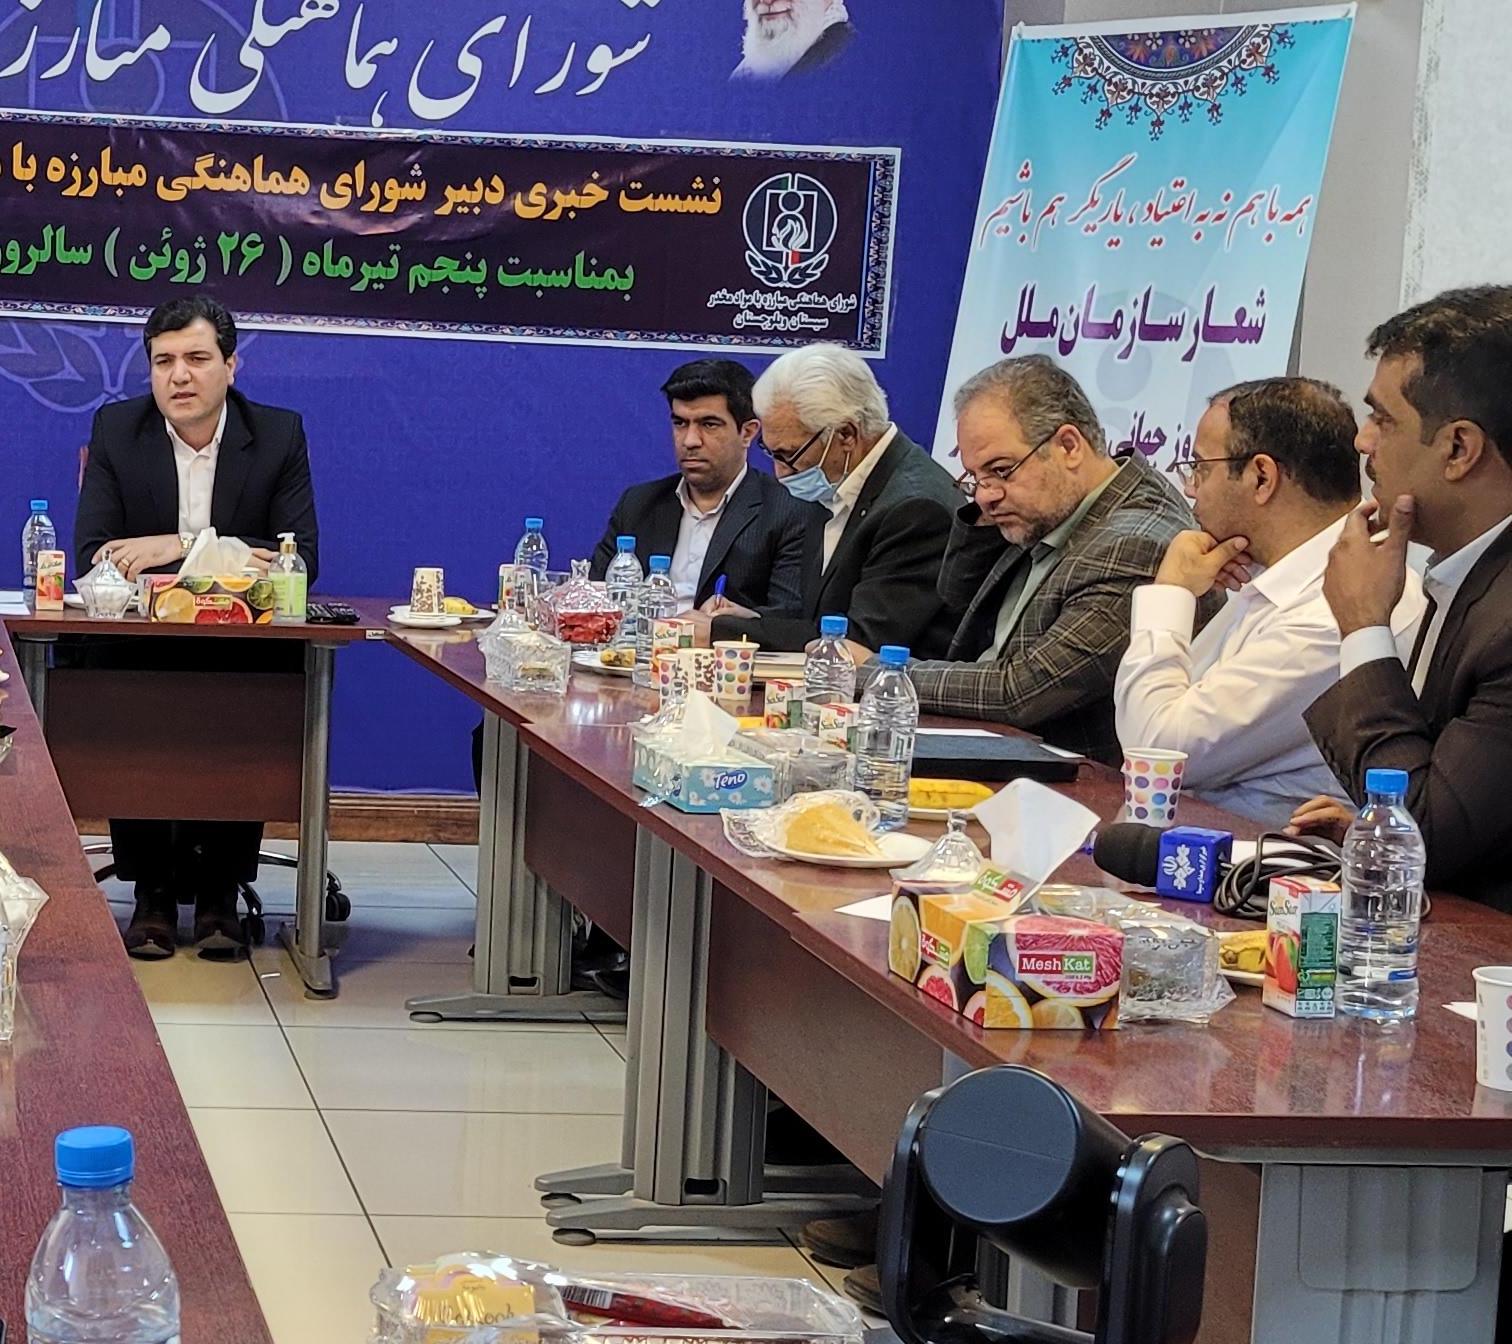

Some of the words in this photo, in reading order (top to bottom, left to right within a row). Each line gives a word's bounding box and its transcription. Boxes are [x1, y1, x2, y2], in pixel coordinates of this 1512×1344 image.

[11, 141, 38, 194] با
[45, 146, 148, 198] مبارزه
[155, 152, 312, 202] هماهنگی
[319, 158, 428, 212] شورای
[433, 172, 506, 219] دبیر
[513, 171, 610, 221] خبری
[618, 175, 723, 216] نشست
[977, 160, 1032, 248] باشیم
[1225, 190, 1266, 251] هم
[1280, 194, 1313, 236] همه
[1031, 194, 1066, 250] هم
[128, 226, 207, 285] ژوئن
[302, 240, 400, 293] تیرماه
[408, 248, 489, 300] پنجم
[496, 250, 635, 302] بمناسبت
[707, 288, 734, 308] مخدر
[788, 291, 829, 311] هماهنگی
[788, 311, 829, 332] سیستان
[827, 293, 858, 313] شورای
[1000, 281, 1060, 354] ملل
[1058, 282, 1187, 361] سازمان
[1181, 286, 1266, 362] شعار
[715, 772, 746, 789] Teno
[1021, 955, 1092, 972] MeshKat
